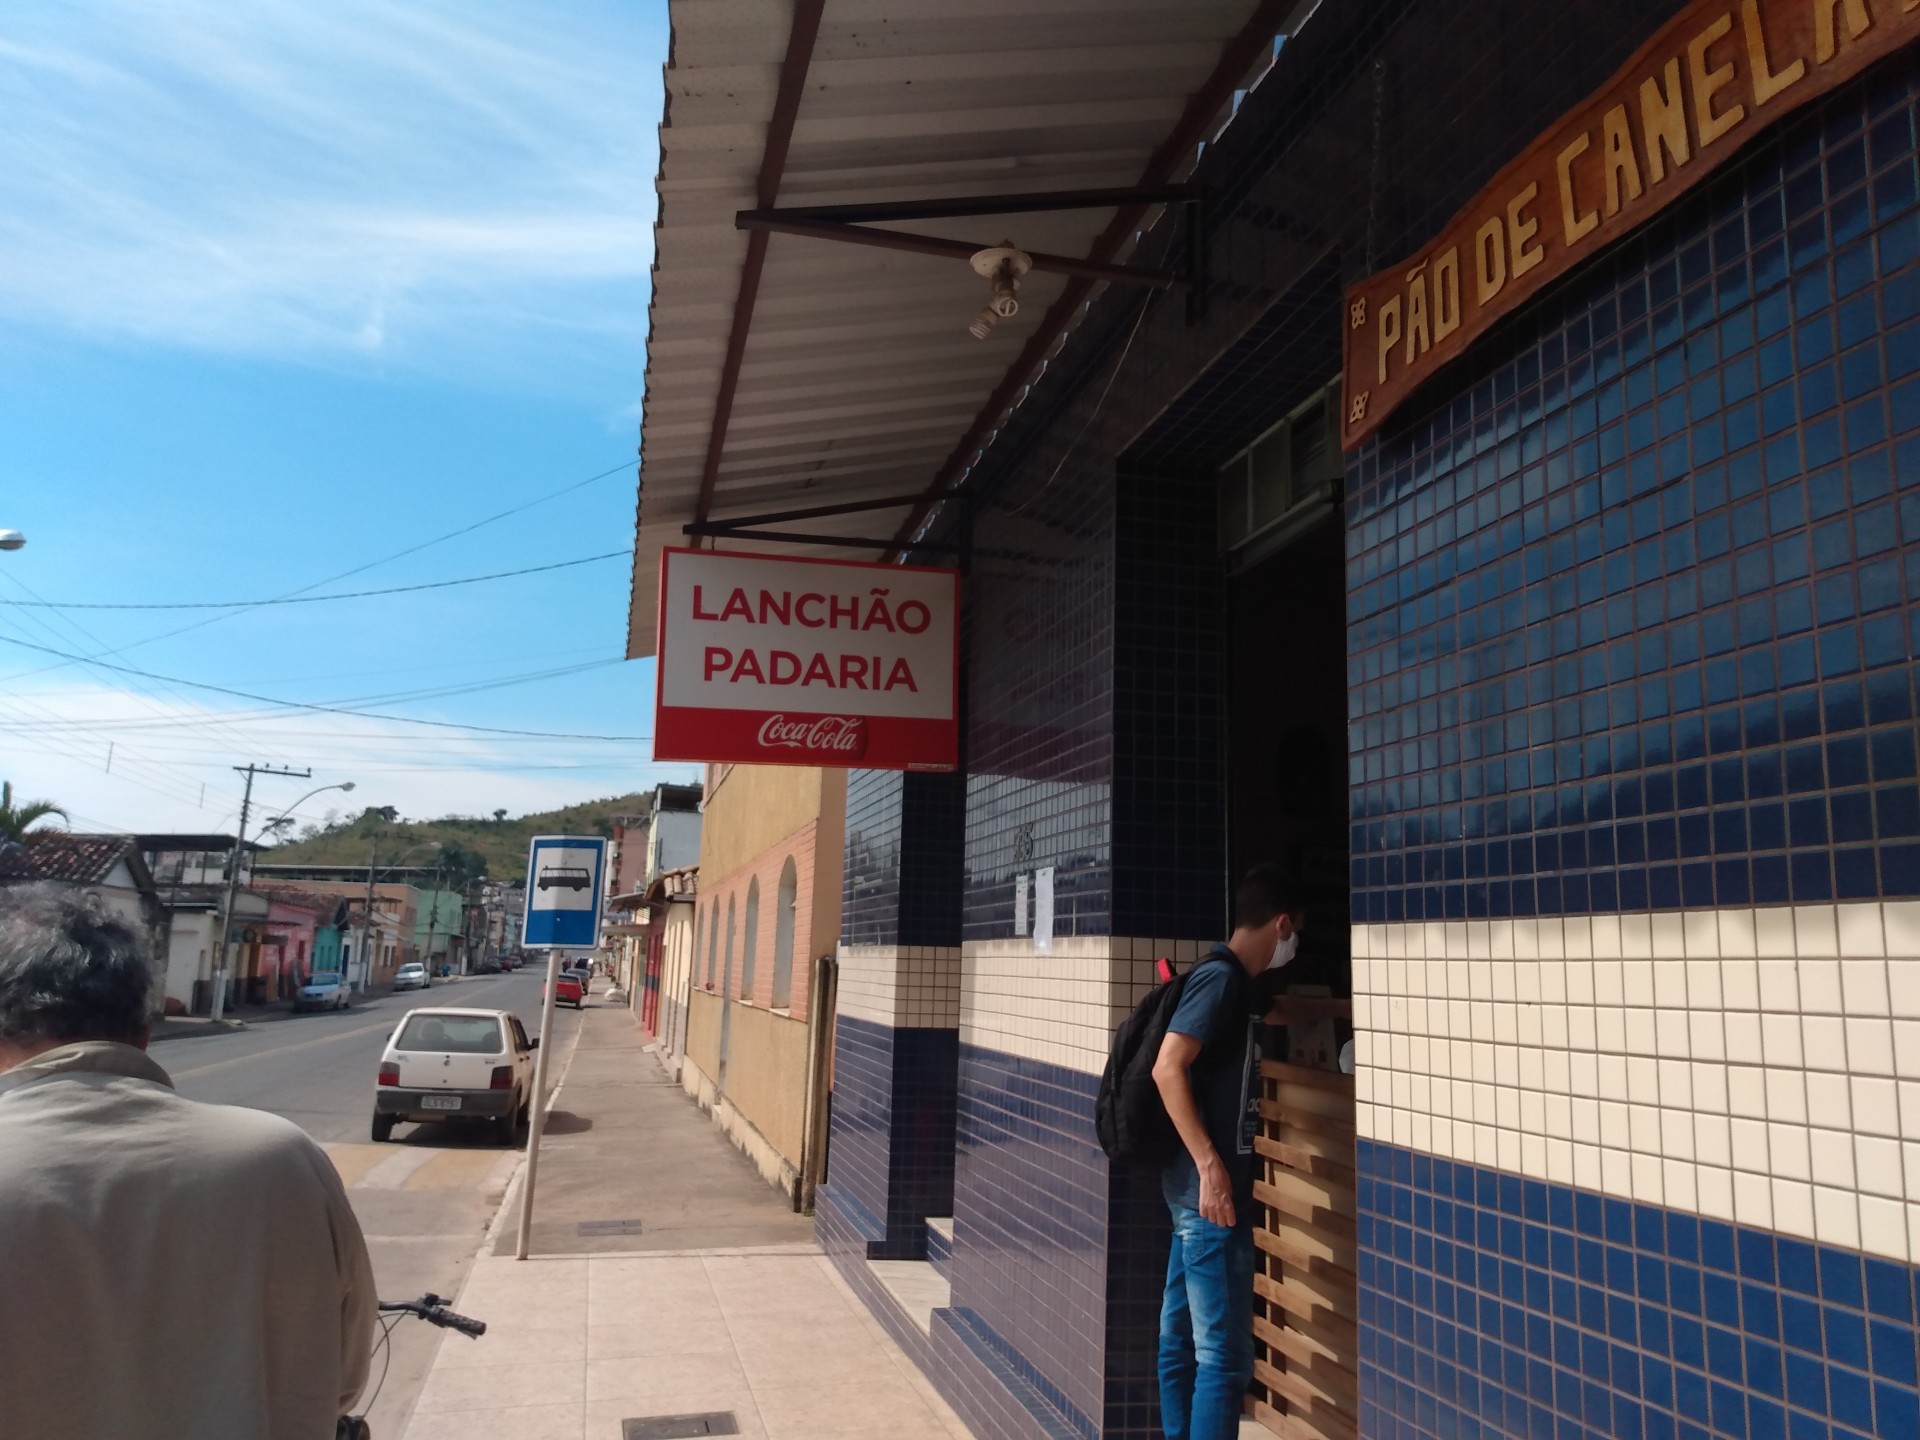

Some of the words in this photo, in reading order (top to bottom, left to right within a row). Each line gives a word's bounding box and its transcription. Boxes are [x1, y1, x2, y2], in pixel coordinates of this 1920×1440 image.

[1378, 246, 1460, 385] PÃO
[1475, 180, 1544, 306] DE
[692, 584, 932, 635] LANCHÃO
[703, 646, 918, 693] PADARIA
[757, 713, 863, 750] Coca-Cola
